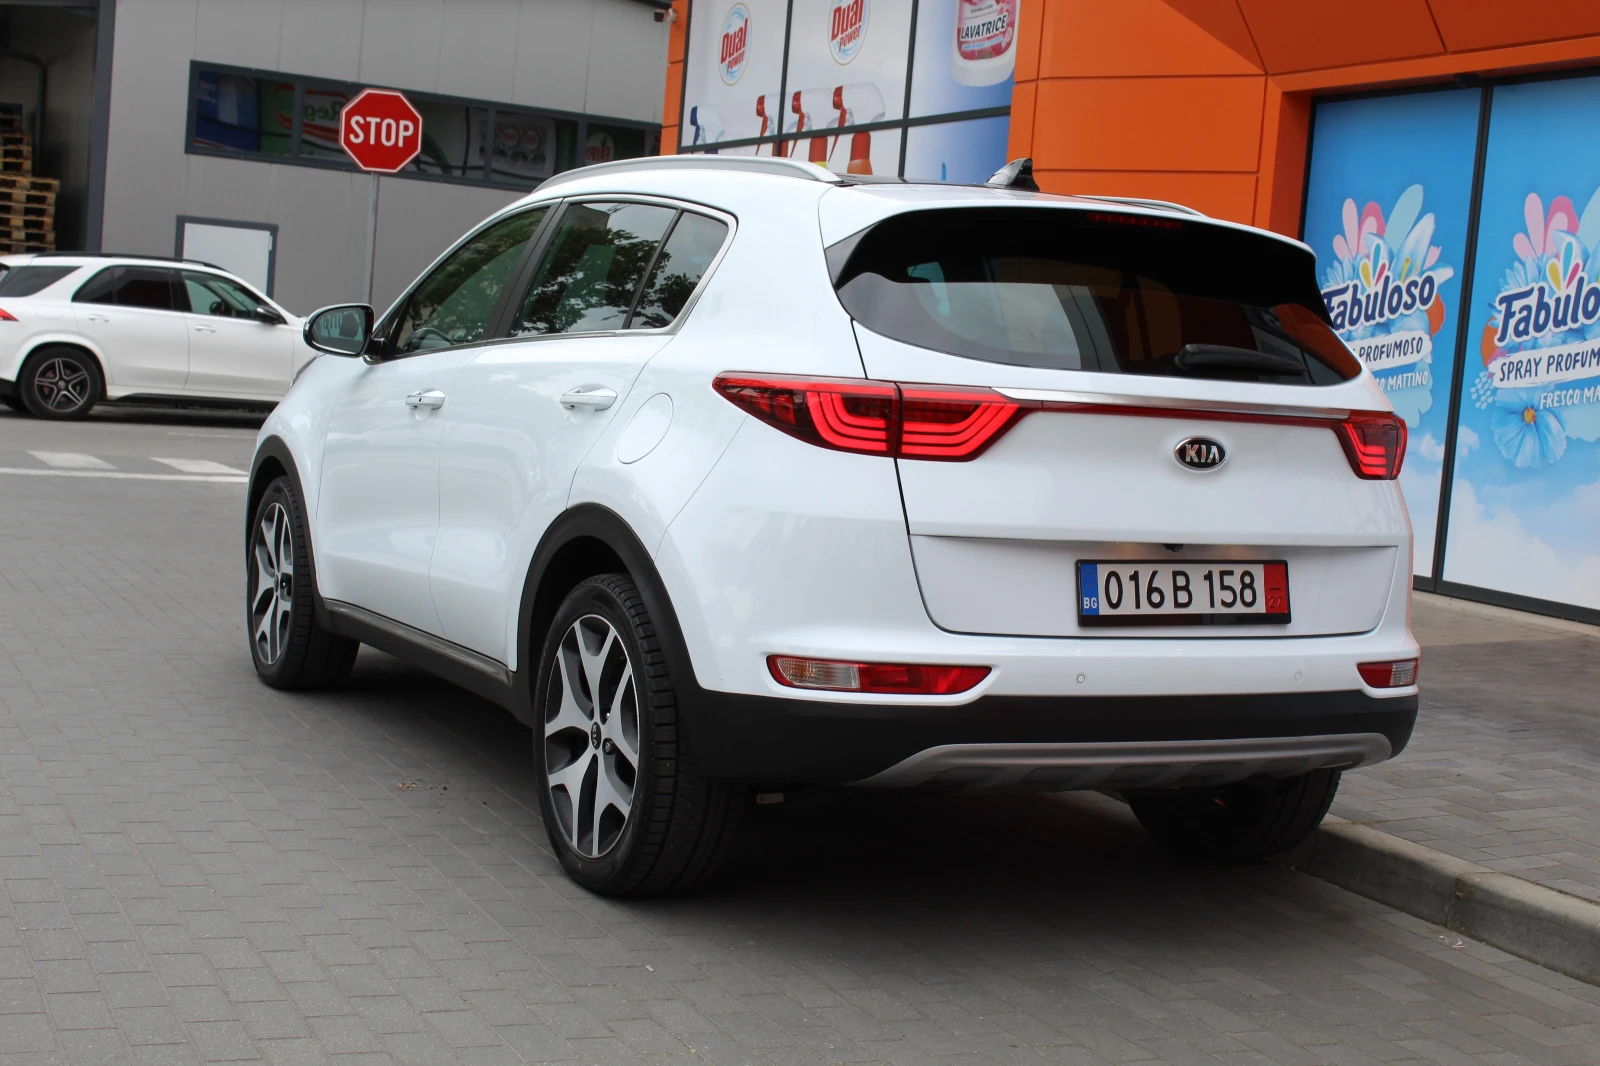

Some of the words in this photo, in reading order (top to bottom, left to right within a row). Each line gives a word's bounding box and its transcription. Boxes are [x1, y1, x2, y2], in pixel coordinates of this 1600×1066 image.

[831, 0, 864, 42] Dual
[960, 14, 1007, 40] LAVATRICE
[720, 17, 749, 65] Dual
[349, 115, 414, 148] STOP
[1321, 274, 1435, 331] Fabuloso
[1358, 336, 1423, 363] PROFUMOSO
[1387, 370, 1428, 391] MATTINO
[1499, 356, 1542, 382] SPRAY
[1540, 388, 1581, 410] FRESCO
[1184, 444, 1220, 463] KIA
[1083, 597, 1098, 610] BG
